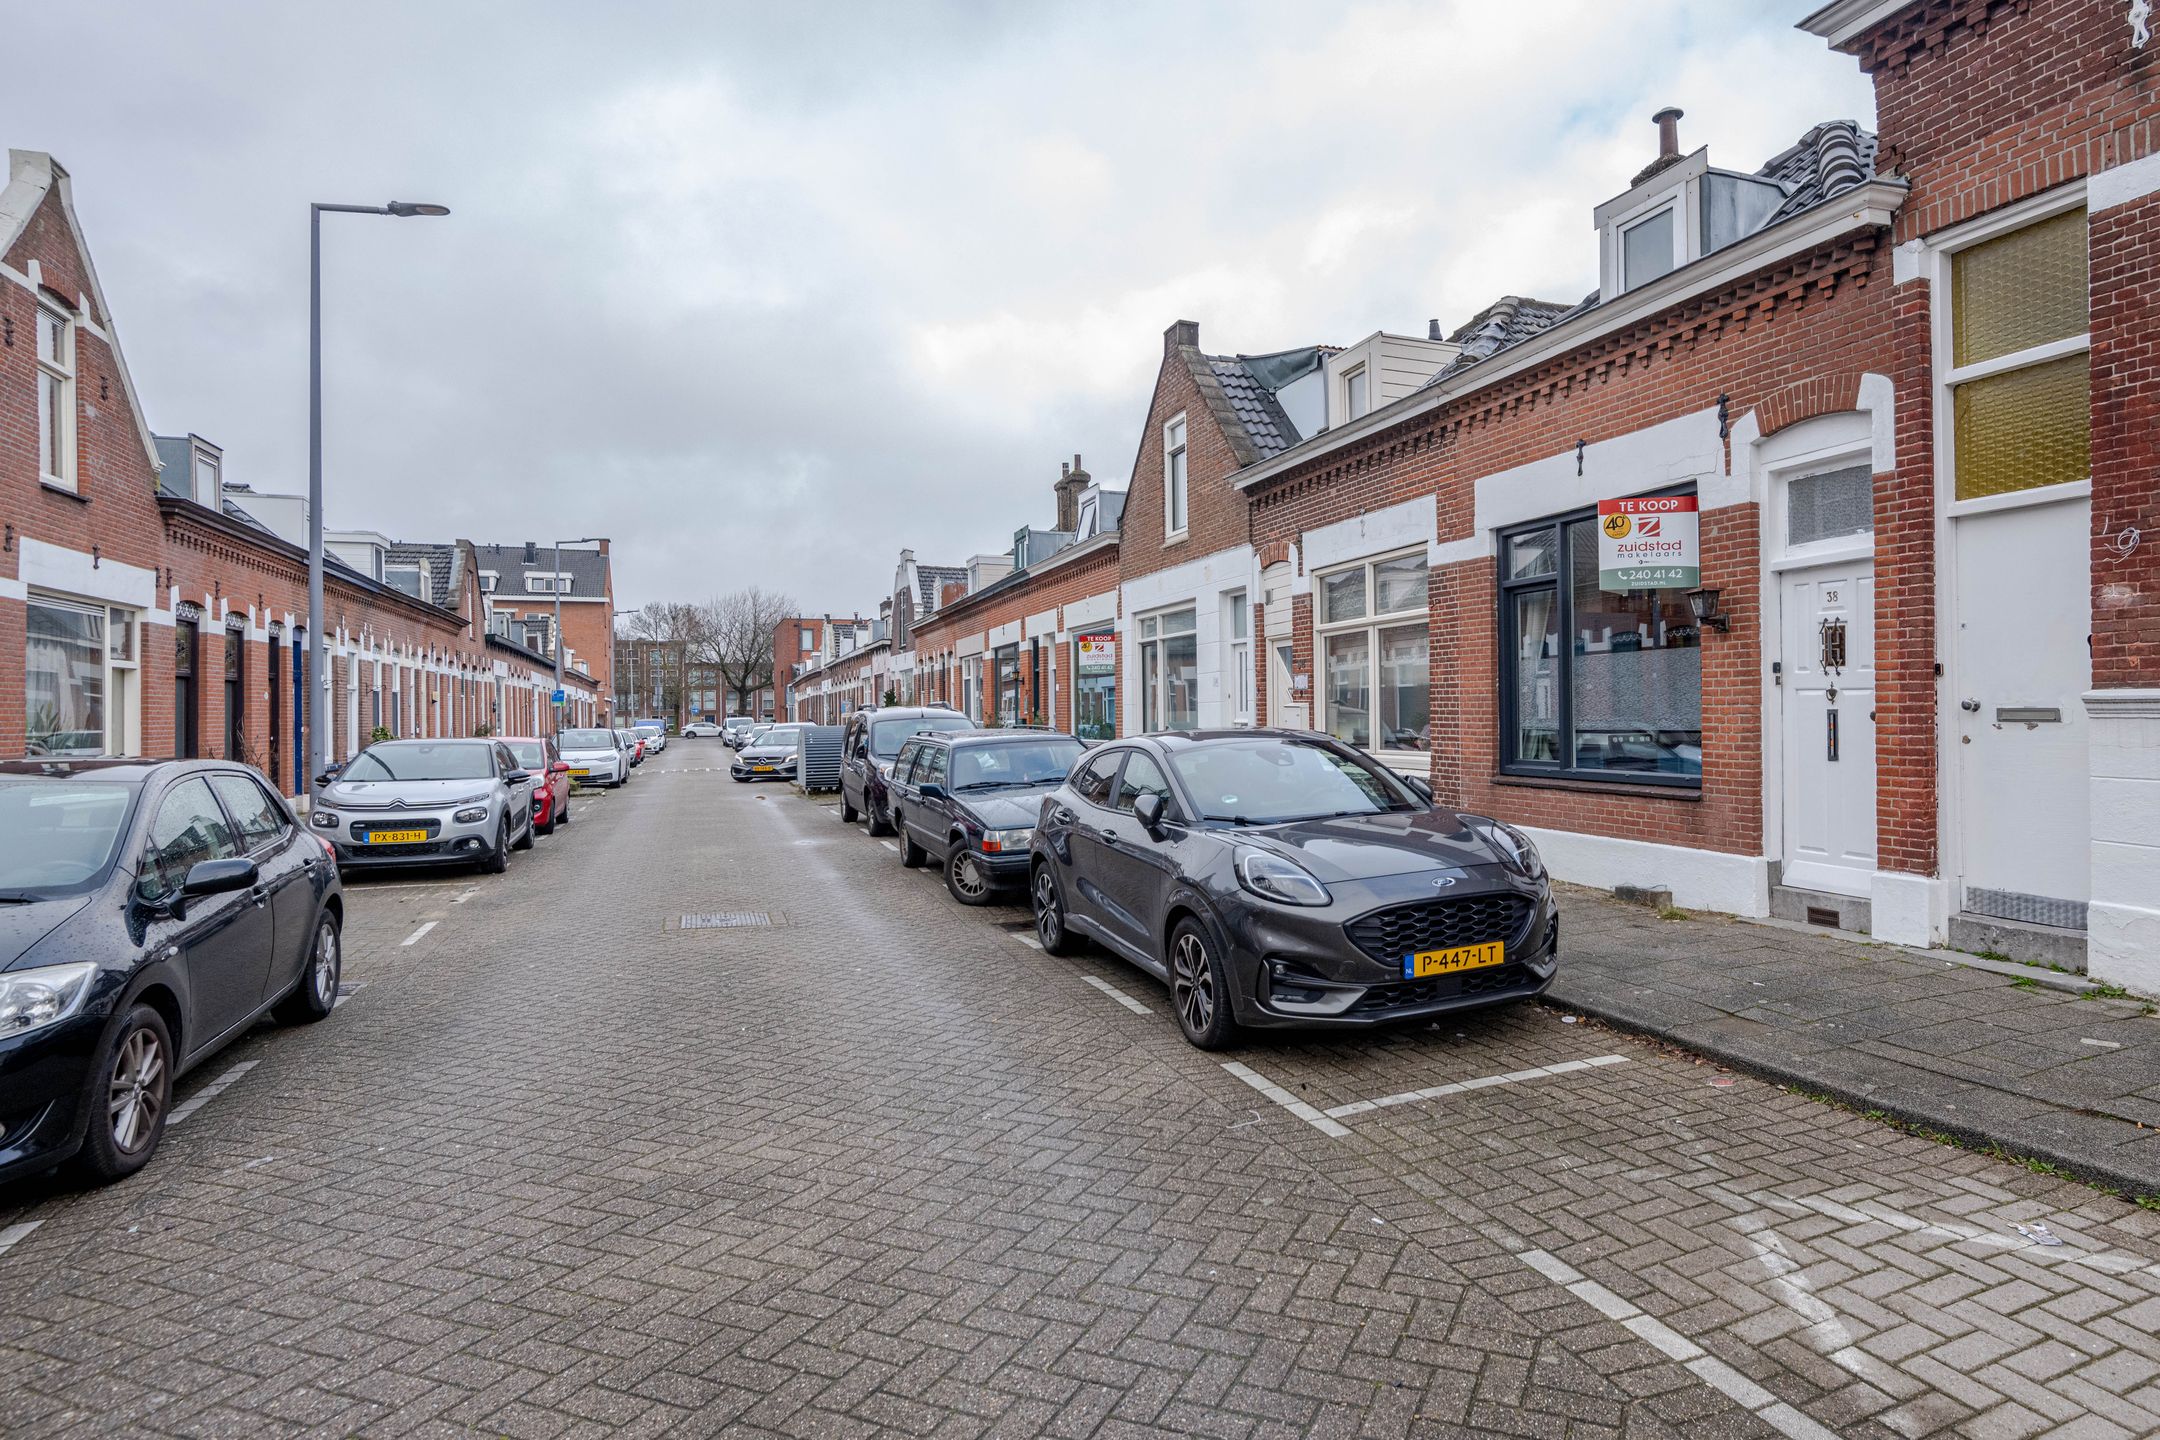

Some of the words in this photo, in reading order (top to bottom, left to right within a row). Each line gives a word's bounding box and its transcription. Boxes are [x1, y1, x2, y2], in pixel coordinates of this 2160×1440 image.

[1619, 501, 1634, 512] TE
[1639, 500, 1678, 511] KOOP
[1617, 540, 1682, 552] zuidstad
[1629, 570, 1651, 580] 240
[1653, 570, 1665, 578] 41
[1668, 569, 1683, 578] 42
[1826, 591, 1838, 602] 38
[374, 832, 421, 841] PX-831-H
[1422, 945, 1496, 972] P-447-LT
